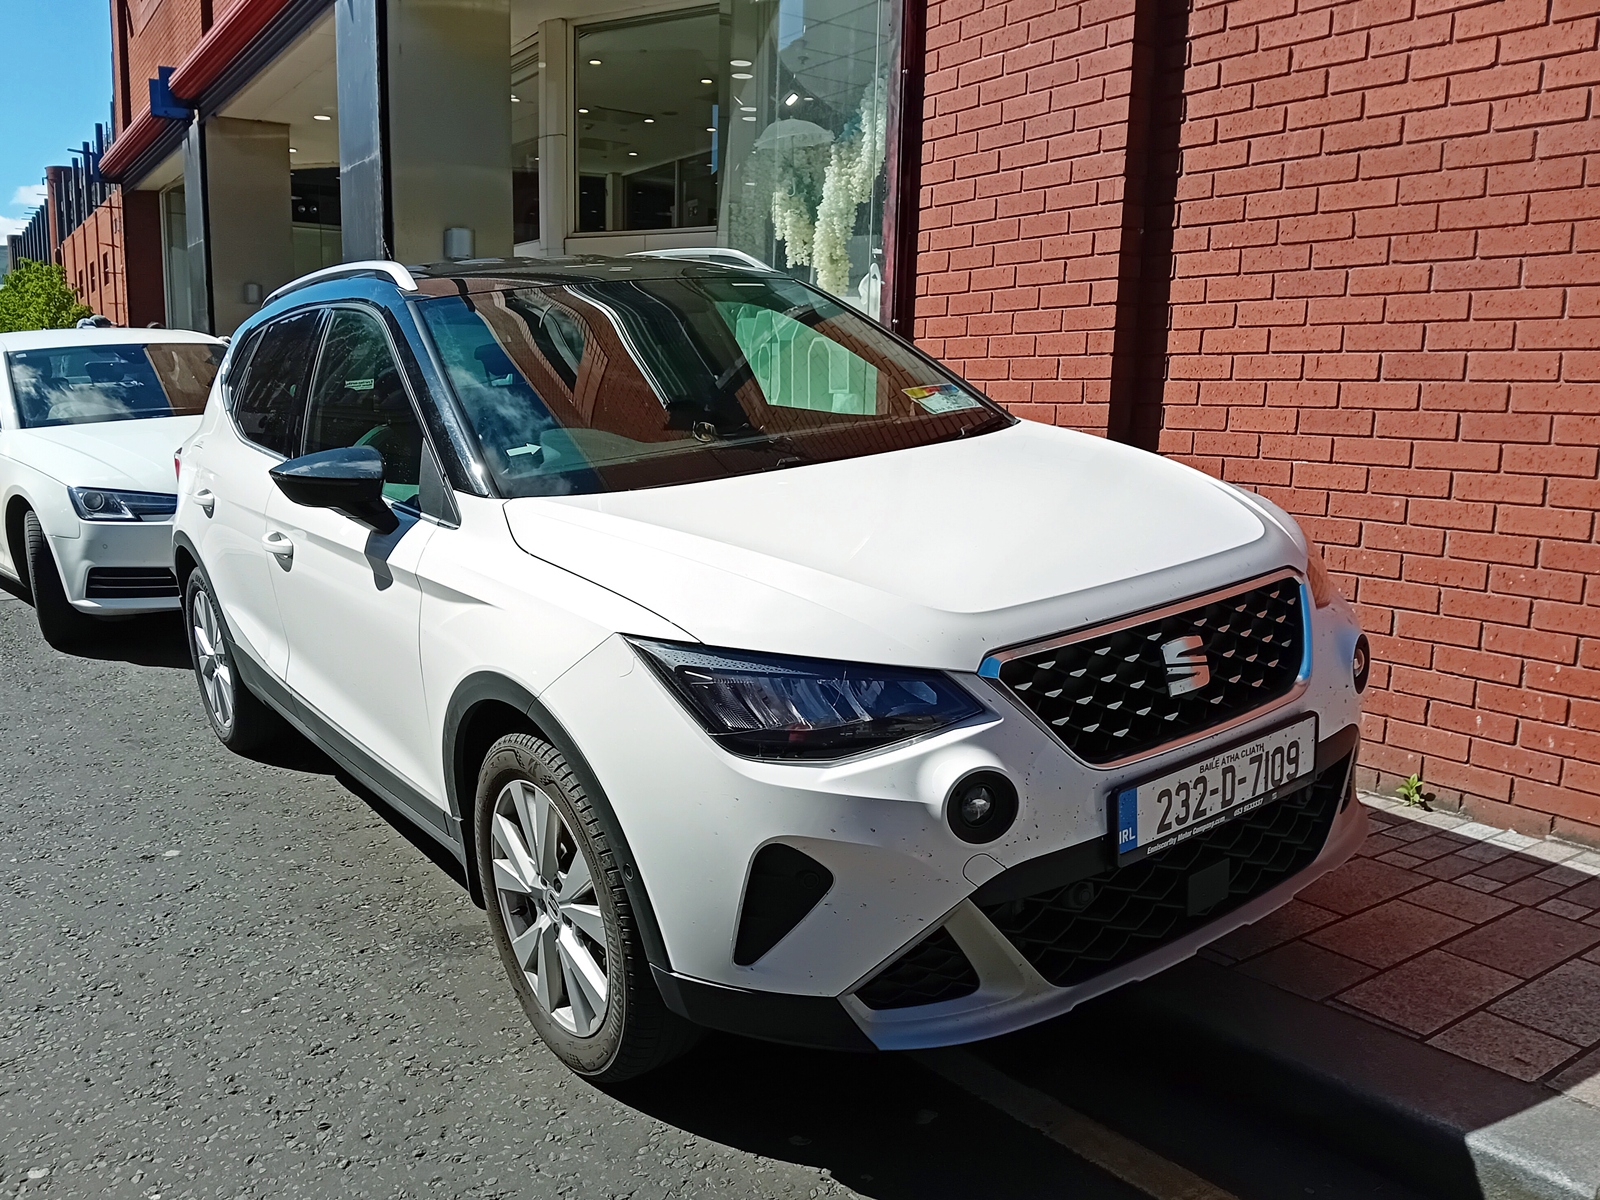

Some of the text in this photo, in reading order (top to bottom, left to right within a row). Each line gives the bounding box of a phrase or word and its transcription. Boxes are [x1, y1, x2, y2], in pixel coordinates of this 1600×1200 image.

[1240, 742, 1265, 759] CLIATH
[1156, 740, 1300, 834] 232-D-7109
[1119, 826, 1136, 845] IRL
[1177, 829, 1193, 842] Motor
